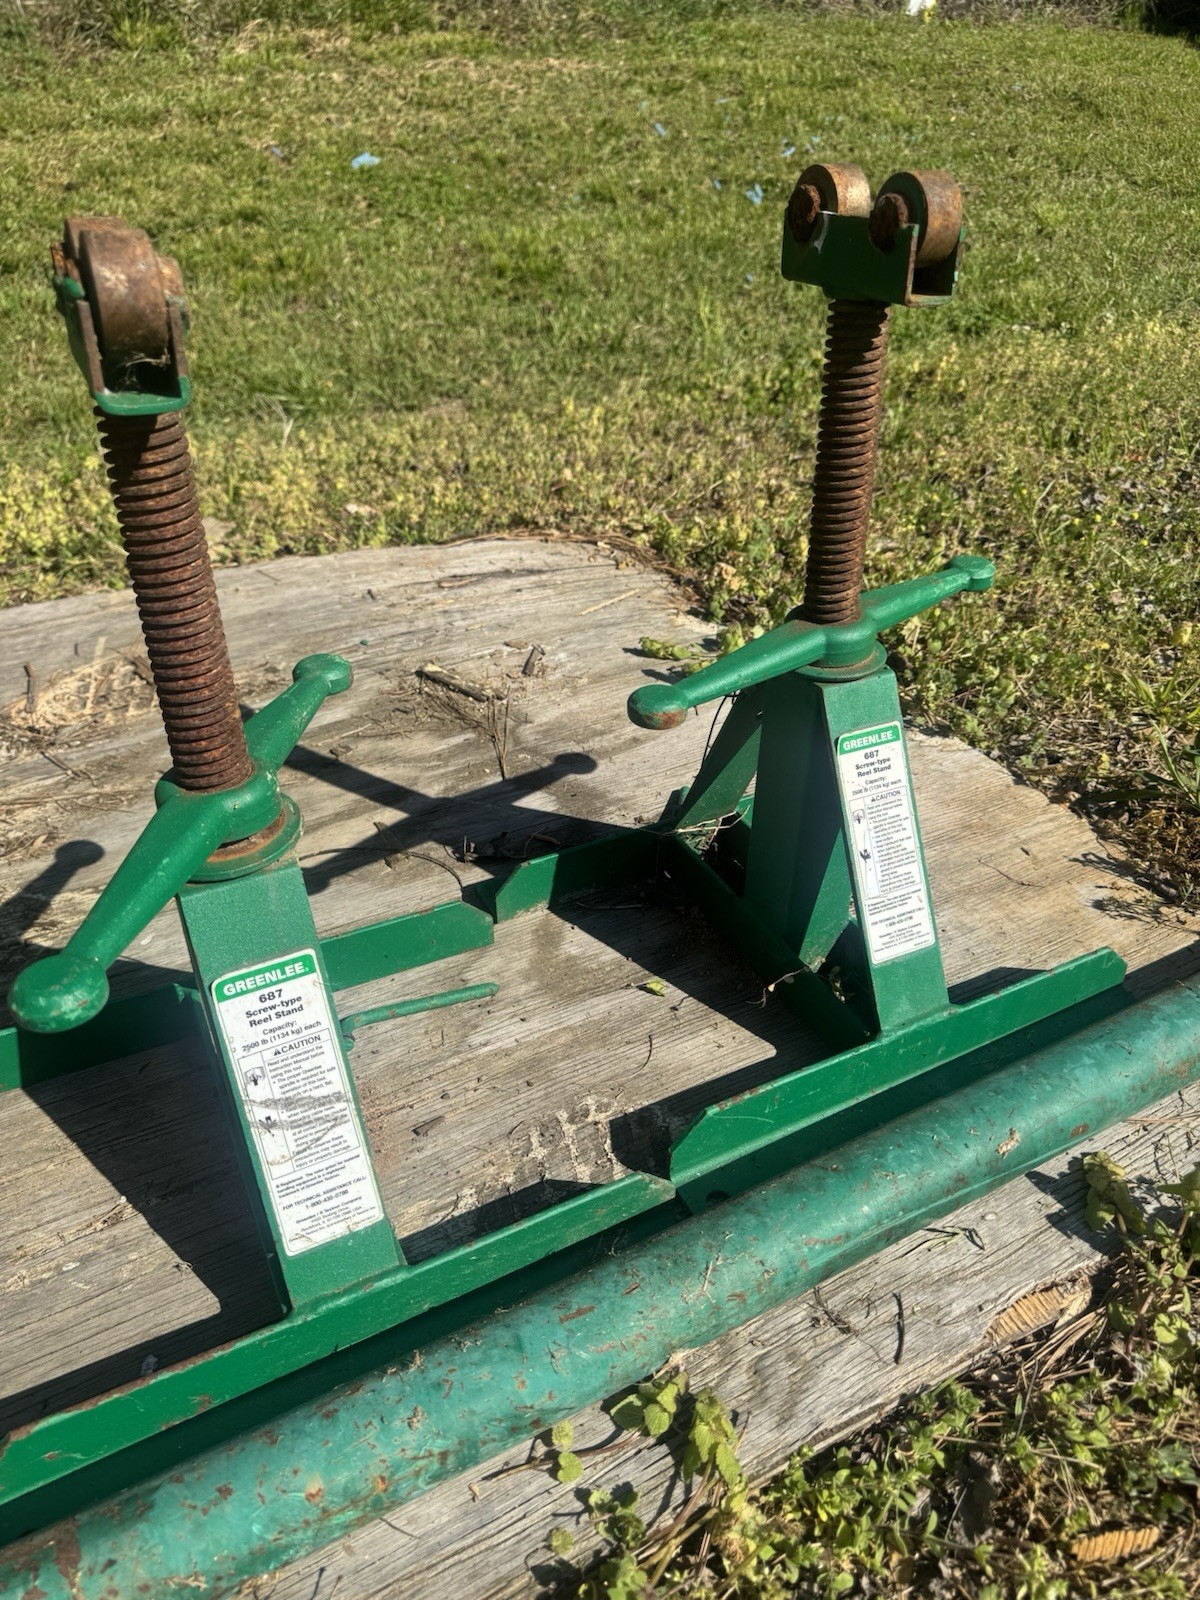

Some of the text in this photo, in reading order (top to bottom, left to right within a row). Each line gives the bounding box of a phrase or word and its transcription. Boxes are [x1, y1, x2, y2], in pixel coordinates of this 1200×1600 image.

[864, 750, 880, 760] 687
[856, 756, 891, 771] Screw-type
[857, 764, 891, 777] Reel Stand
[876, 789, 901, 801] CAUTION
[258, 988, 284, 1004] 687
[245, 995, 303, 1019] Screw-type
[249, 1004, 304, 1028] Reel Stand
[262, 1019, 298, 1036] Capacity:
[242, 1041, 260, 1052] 2500
[270, 1032, 290, 1043] (1134
[291, 1027, 303, 1036] kg)
[304, 1021, 322, 1031] each
[281, 1035, 321, 1053] CAUTION
[282, 1203, 294, 1211] FOR
